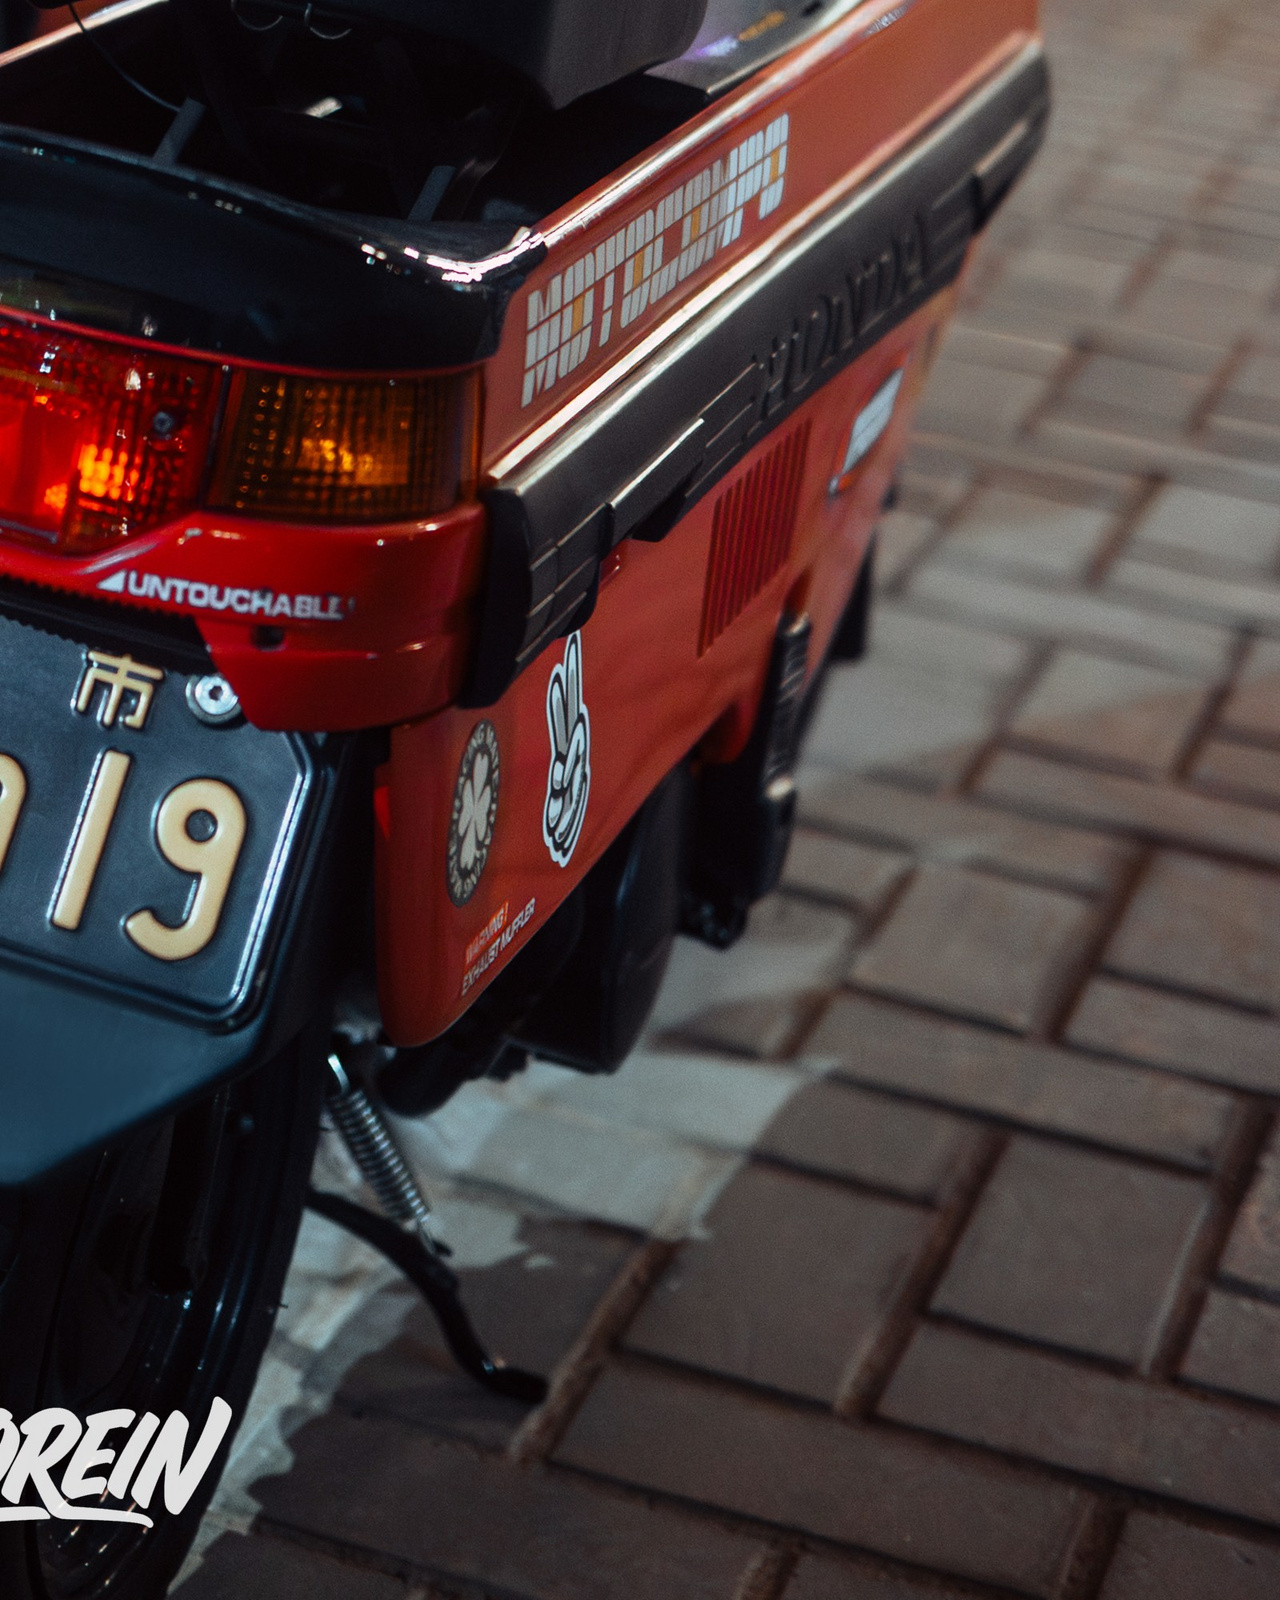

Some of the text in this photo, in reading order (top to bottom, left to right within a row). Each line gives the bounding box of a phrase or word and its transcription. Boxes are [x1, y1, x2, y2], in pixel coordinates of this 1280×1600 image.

[521, 112, 790, 408] MOTOCOMPO
[750, 212, 928, 420] HONDA
[461, 897, 536, 997] EXHAUST MUFFLER
